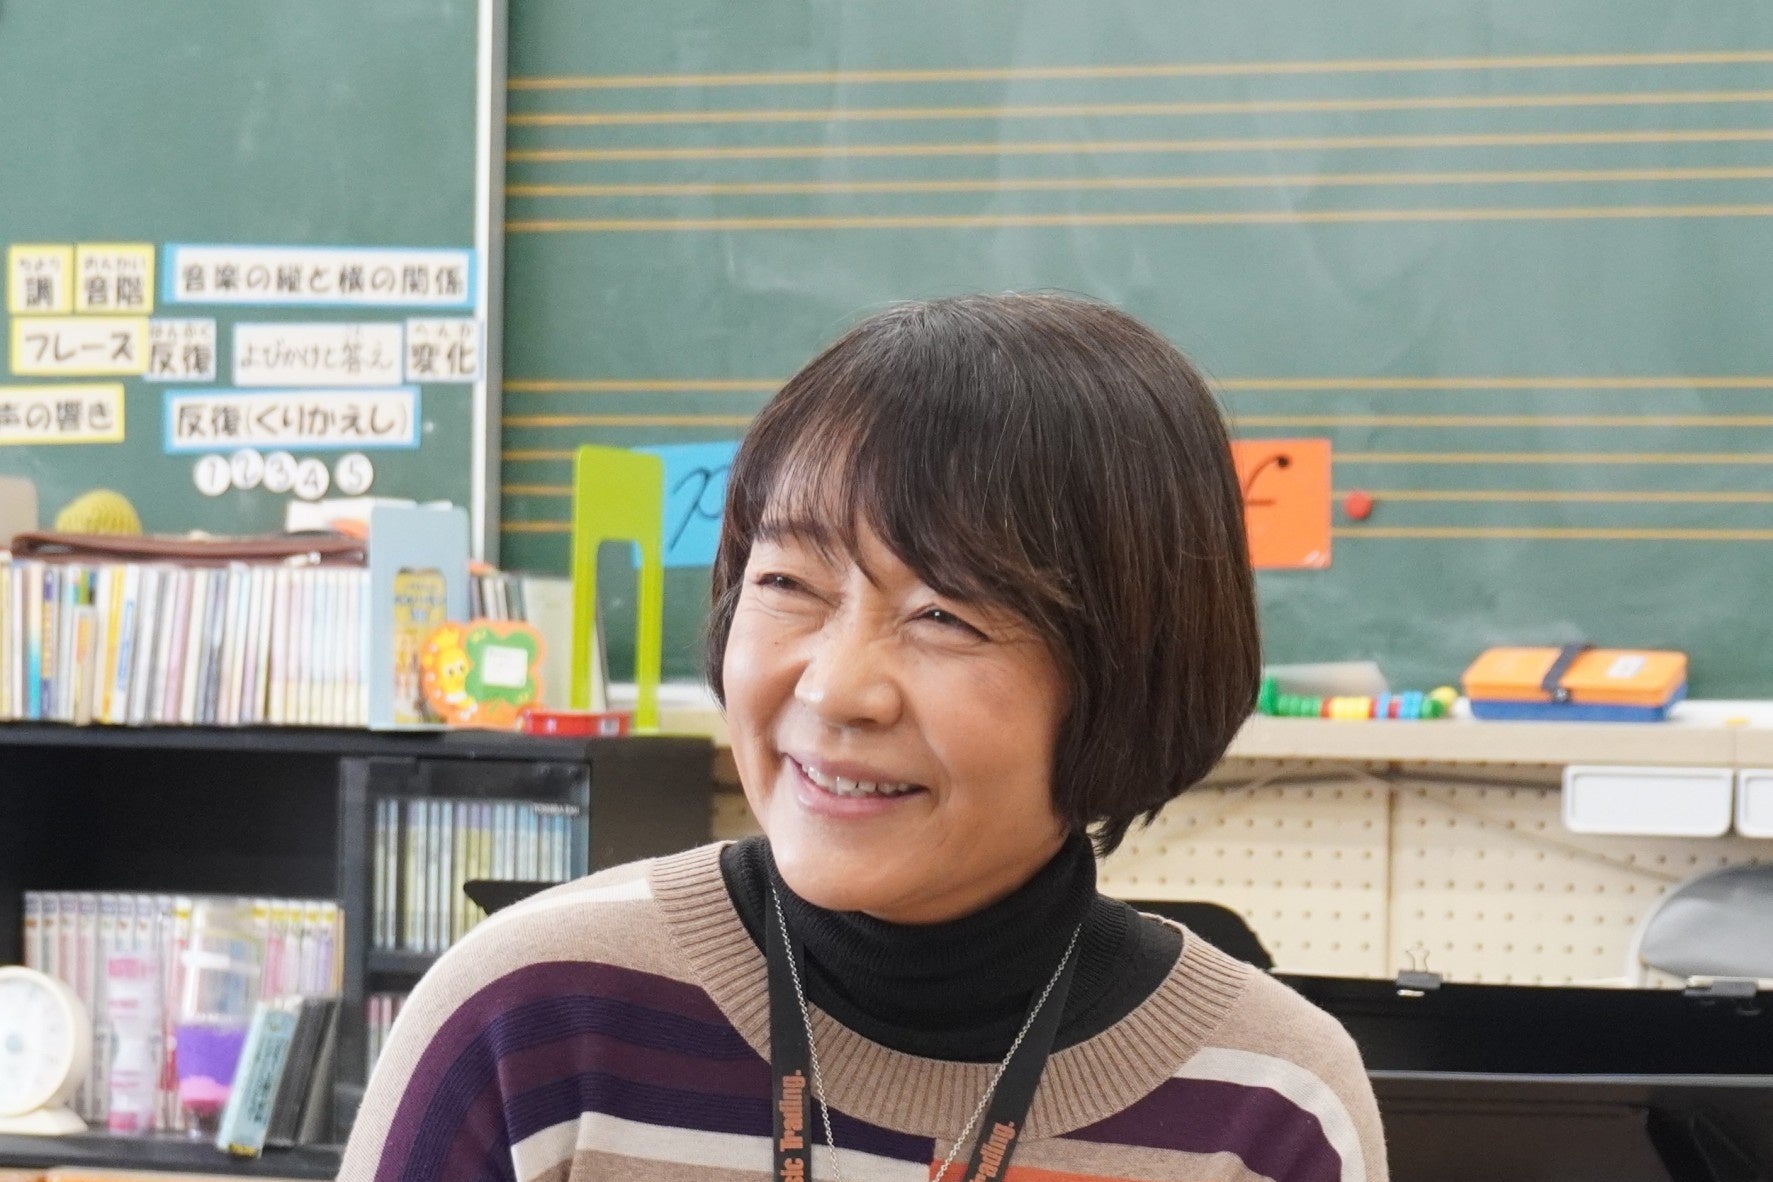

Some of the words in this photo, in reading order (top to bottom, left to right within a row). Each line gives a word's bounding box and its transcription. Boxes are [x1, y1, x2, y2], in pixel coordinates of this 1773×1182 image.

[150, 342, 211, 374] 反復
[411, 342, 476, 374] 変化
[779, 1069, 806, 1152] Trading.
